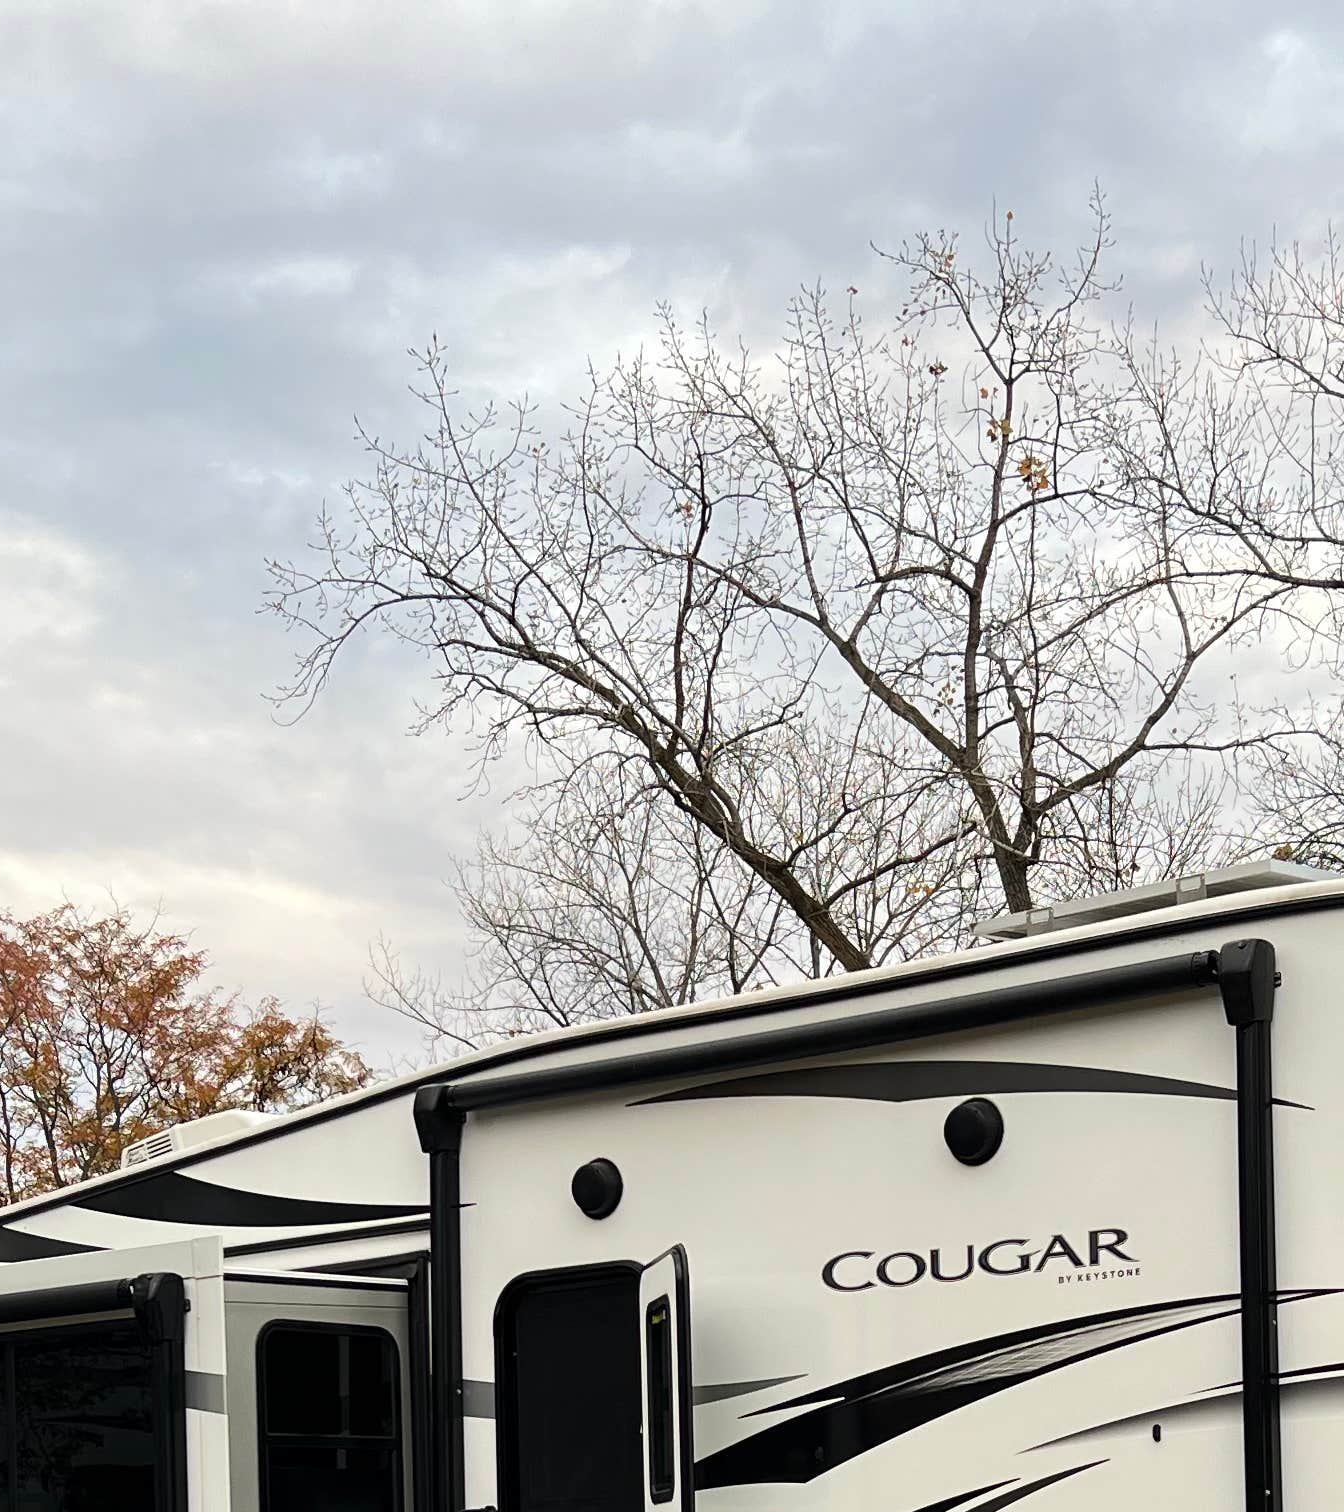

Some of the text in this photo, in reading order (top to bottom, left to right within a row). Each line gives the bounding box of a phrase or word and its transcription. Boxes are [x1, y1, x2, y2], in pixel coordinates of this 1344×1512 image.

[821, 1228, 1141, 1292] COUGAR
[1058, 1267, 1141, 1284] BY KEYSTONE
